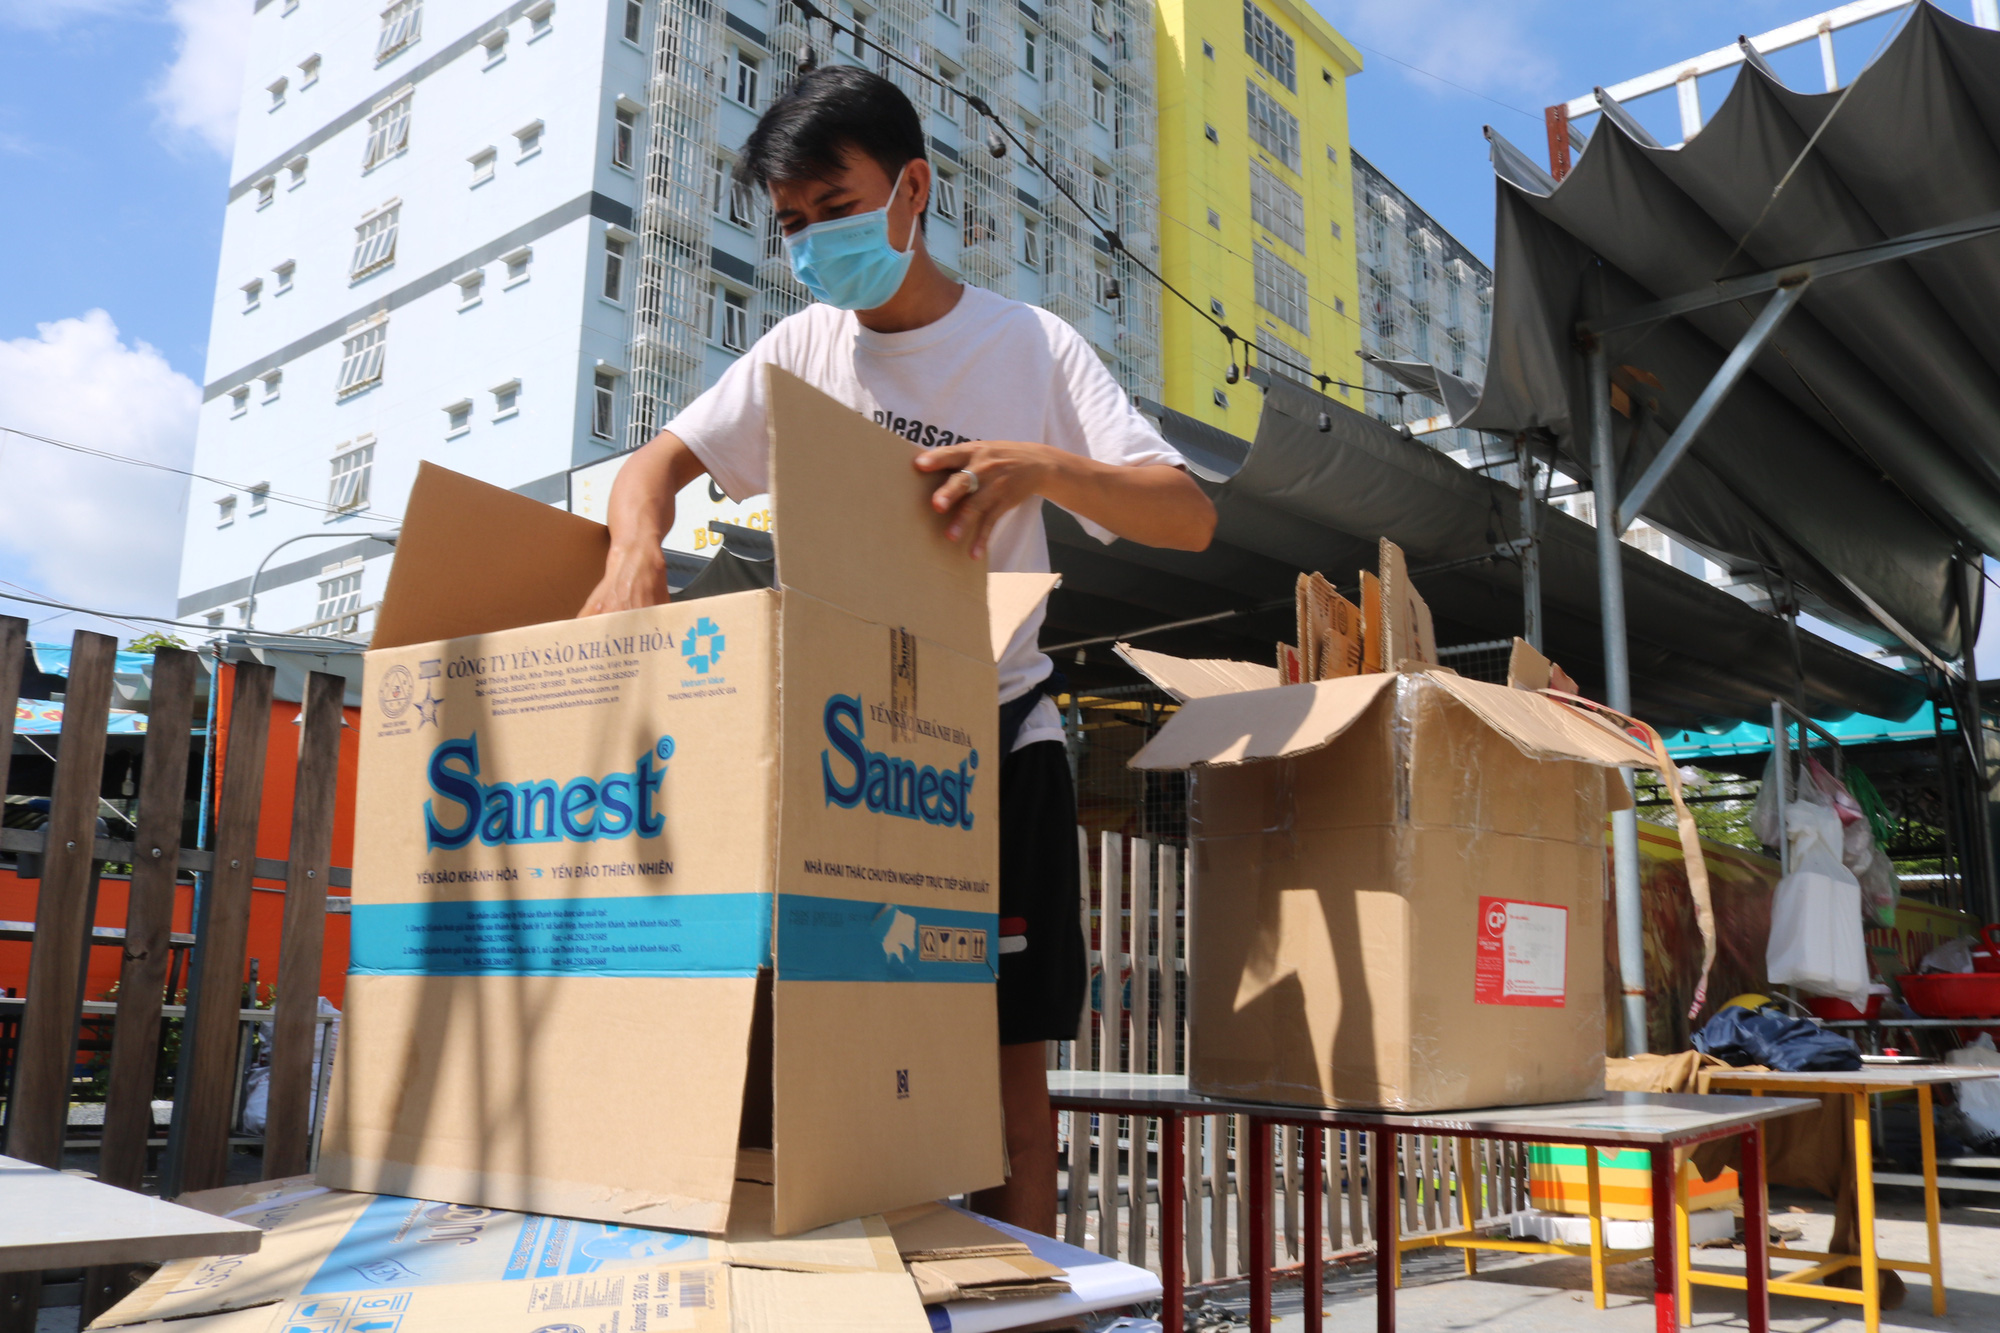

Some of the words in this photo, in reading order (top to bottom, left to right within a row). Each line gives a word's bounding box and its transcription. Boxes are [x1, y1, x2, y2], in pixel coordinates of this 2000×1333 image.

[447, 655, 486, 679] CÔNG
[490, 655, 509, 672] TY
[511, 646, 540, 669] YẾN
[543, 641, 574, 665] SÀO
[578, 635, 635, 662] KHÁNH
[639, 627, 675, 653] HÒA
[821, 693, 975, 831] Sanest
[423, 730, 669, 854] Sanest
[416, 868, 435, 884] YẾN
[436, 869, 456, 883] SÀO
[458, 868, 494, 882] KHÁNH
[496, 866, 519, 881] HÒA
[551, 862, 573, 879] YẾN
[575, 861, 599, 878] ĐẢO
[601, 860, 635, 877] THIÊN
[638, 859, 674, 876] NHIÊN
[804, 859, 823, 875] NHÀ
[824, 862, 844, 877] KHAI
[845, 864, 866, 880] THÁC
[867, 868, 898, 884] CHUYÊN
[899, 872, 925, 889] NGHIỆP
[360, 1261, 408, 1282] NEW
